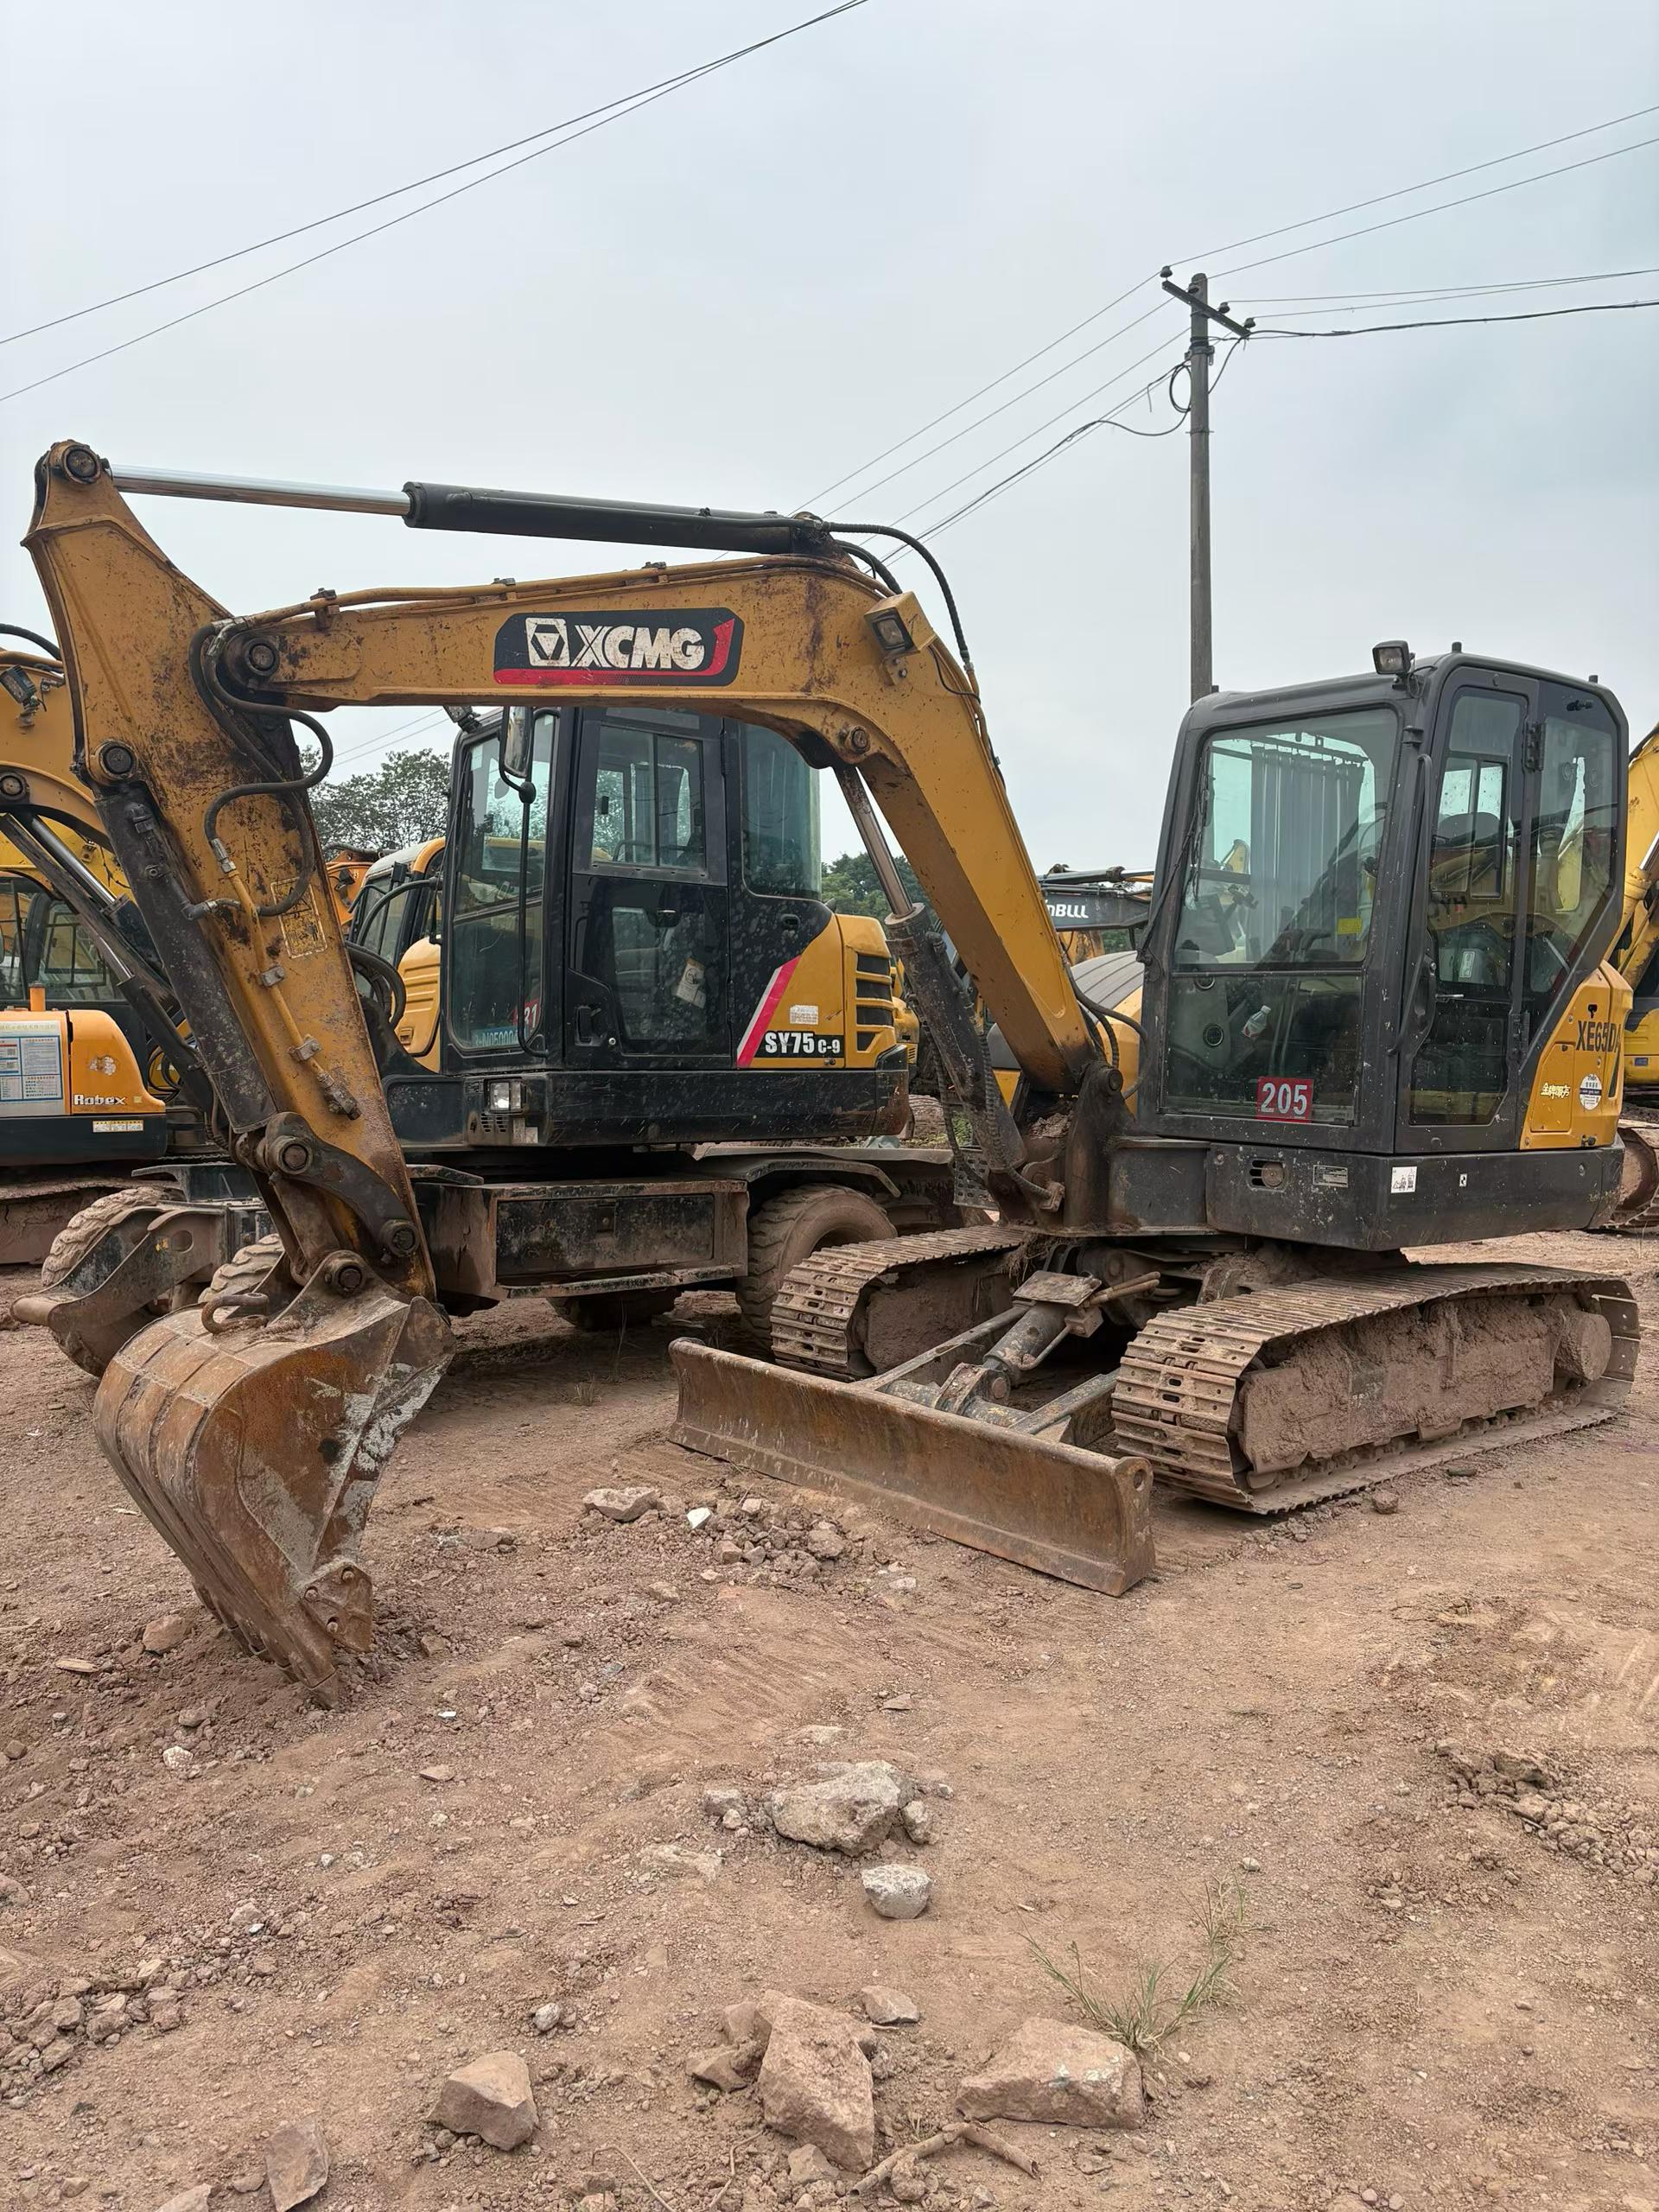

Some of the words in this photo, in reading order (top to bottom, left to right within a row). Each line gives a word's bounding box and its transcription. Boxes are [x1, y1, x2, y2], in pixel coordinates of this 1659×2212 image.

[570, 625, 704, 670] XCMG
[765, 1032, 815, 1054] SY75
[73, 1094, 126, 1106] Robex
[1261, 1082, 1307, 1115] 205
